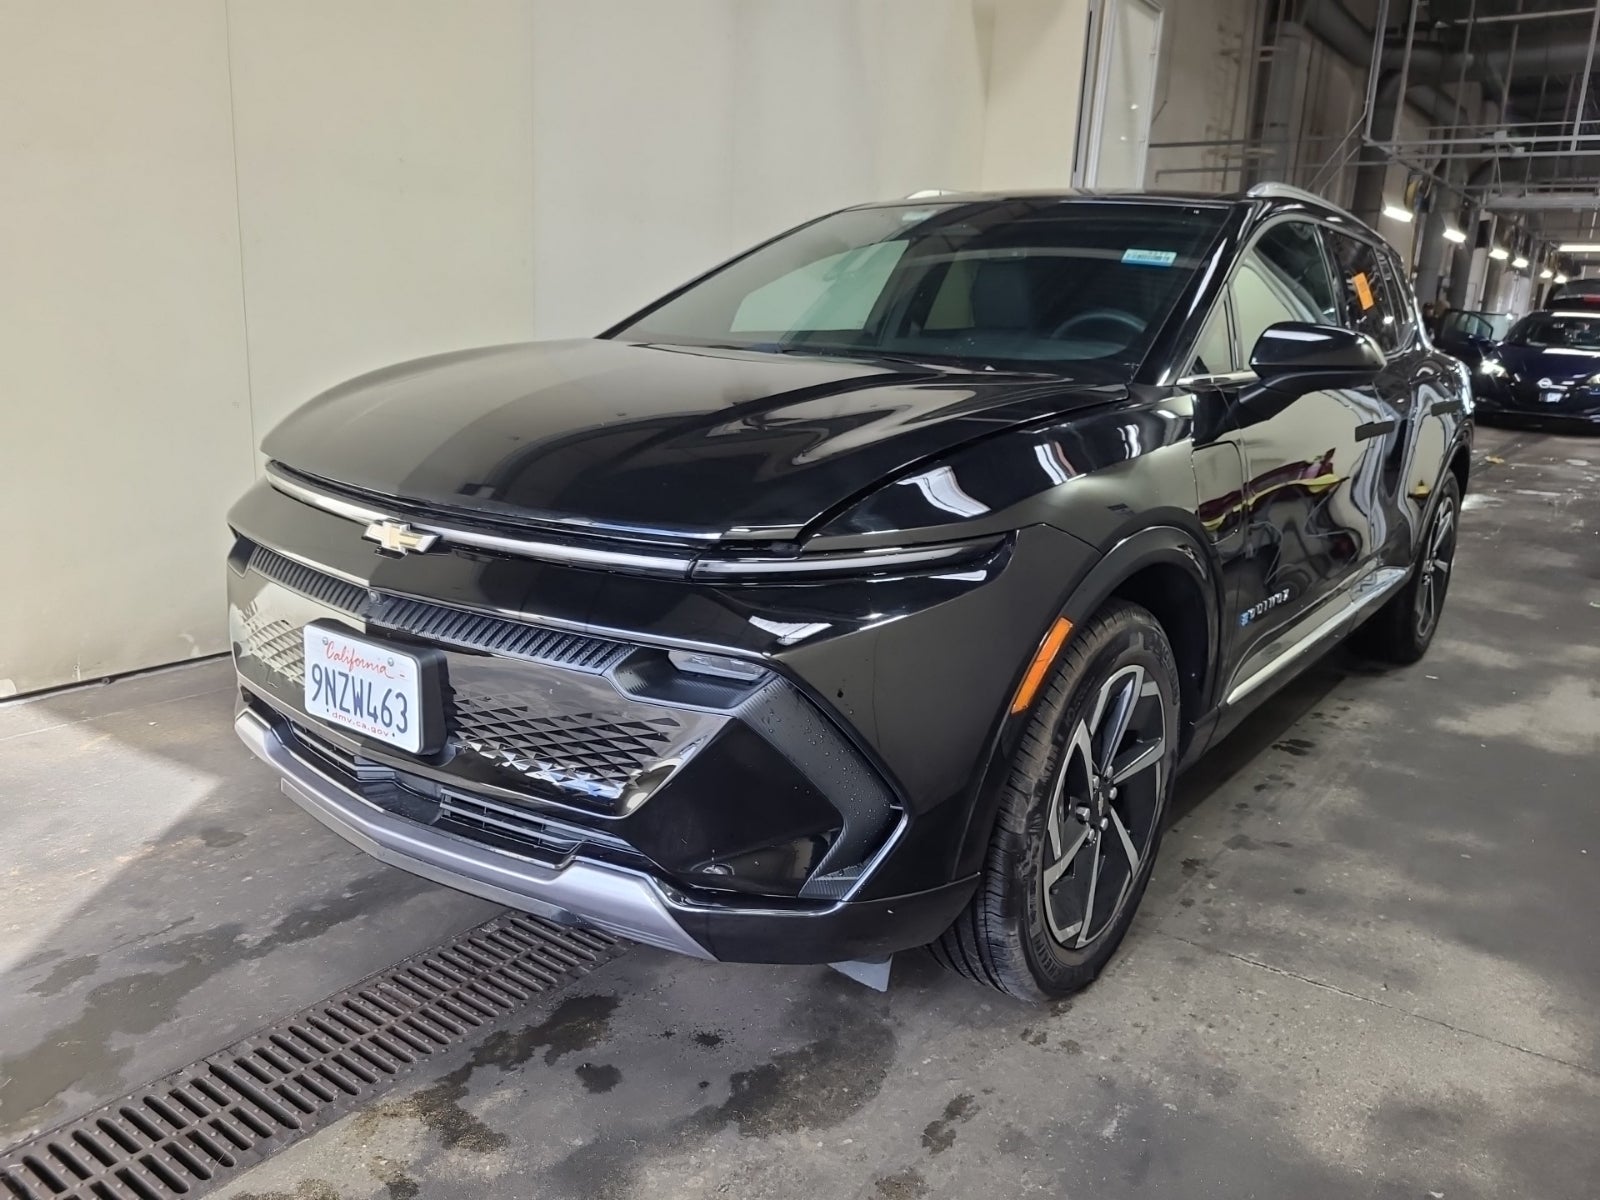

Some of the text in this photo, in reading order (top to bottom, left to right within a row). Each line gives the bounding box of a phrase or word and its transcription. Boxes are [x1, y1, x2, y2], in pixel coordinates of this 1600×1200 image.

[325, 640, 394, 679] California
[311, 663, 408, 734] 9NZW463
[331, 711, 389, 737] dmv.ca.gov
